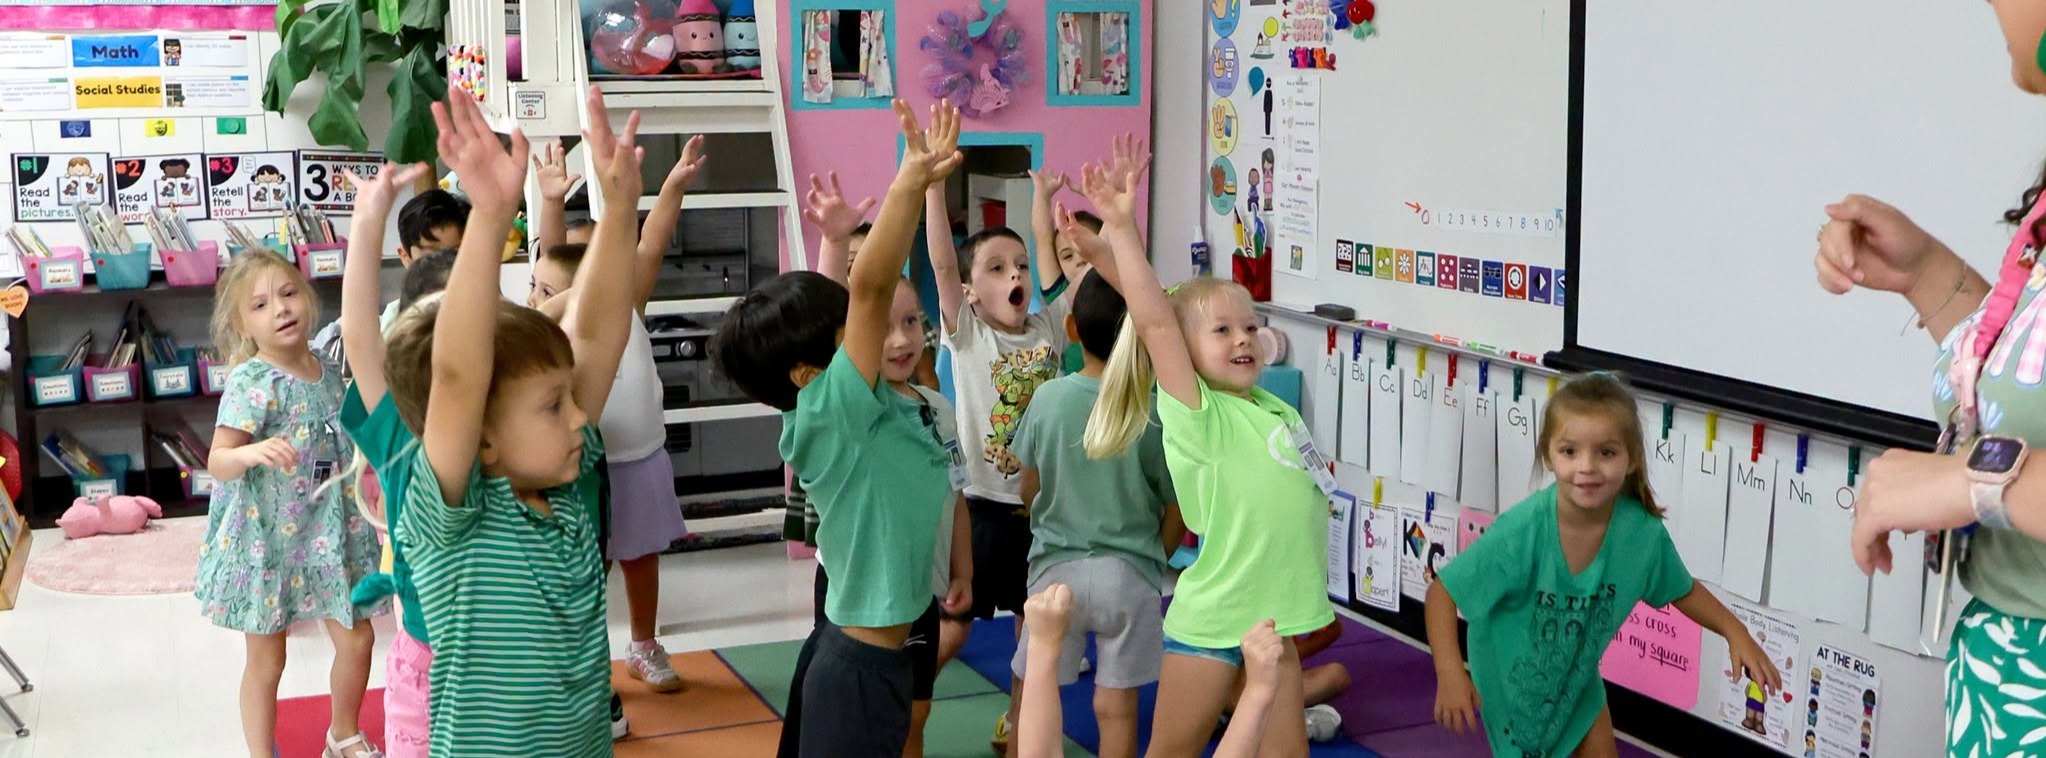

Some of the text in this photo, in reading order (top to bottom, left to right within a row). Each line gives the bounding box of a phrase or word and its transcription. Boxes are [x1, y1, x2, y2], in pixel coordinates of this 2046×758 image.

[91, 44, 140, 59] Math
[75, 84, 113, 95] Social
[116, 84, 161, 95] Studies
[20, 156, 38, 174] #1
[116, 159, 141, 177] #2
[209, 157, 234, 174] #3
[366, 165, 379, 175] TO
[20, 187, 50, 197] Read
[212, 187, 243, 197] Retell
[304, 164, 330, 202] 3
[20, 198, 41, 207] the
[118, 192, 148, 202] Read
[213, 198, 231, 206] the
[20, 208, 75, 218] pictures.
[119, 203, 139, 212] the
[213, 208, 247, 217] story.
[1448, 213, 1453, 224] 2
[1459, 213, 1465, 225] 3
[1471, 214, 1476, 226] 4
[1483, 215, 1488, 227] 5
[1495, 216, 1501, 228] 6
[1508, 216, 1513, 228] 7
[1520, 217, 1526, 229] 8
[1534, 218, 1539, 230] 9
[1544, 219, 1554, 231] 10
[1324, 358, 1337, 376] Aa
[1352, 363, 1365, 382] Bb
[1380, 374, 1395, 393] Cc
[1413, 379, 1427, 399] Dd
[1444, 387, 1457, 407] Ee
[1476, 398, 1489, 417] Ff
[1508, 407, 1527, 436] Gg
[1656, 439, 1674, 464] Kk
[1737, 462, 1765, 491] Mm
[1790, 478, 1812, 505] Nn
[1645, 616, 1677, 638] cross
[1750, 615, 1766, 630] Body
[1768, 622, 1800, 644] Listening
[1629, 635, 1647, 659] my
[1650, 642, 1690, 669] square
[1817, 646, 1830, 660] AT
[1833, 651, 1852, 669] THE
[1853, 659, 1875, 678] RUG
